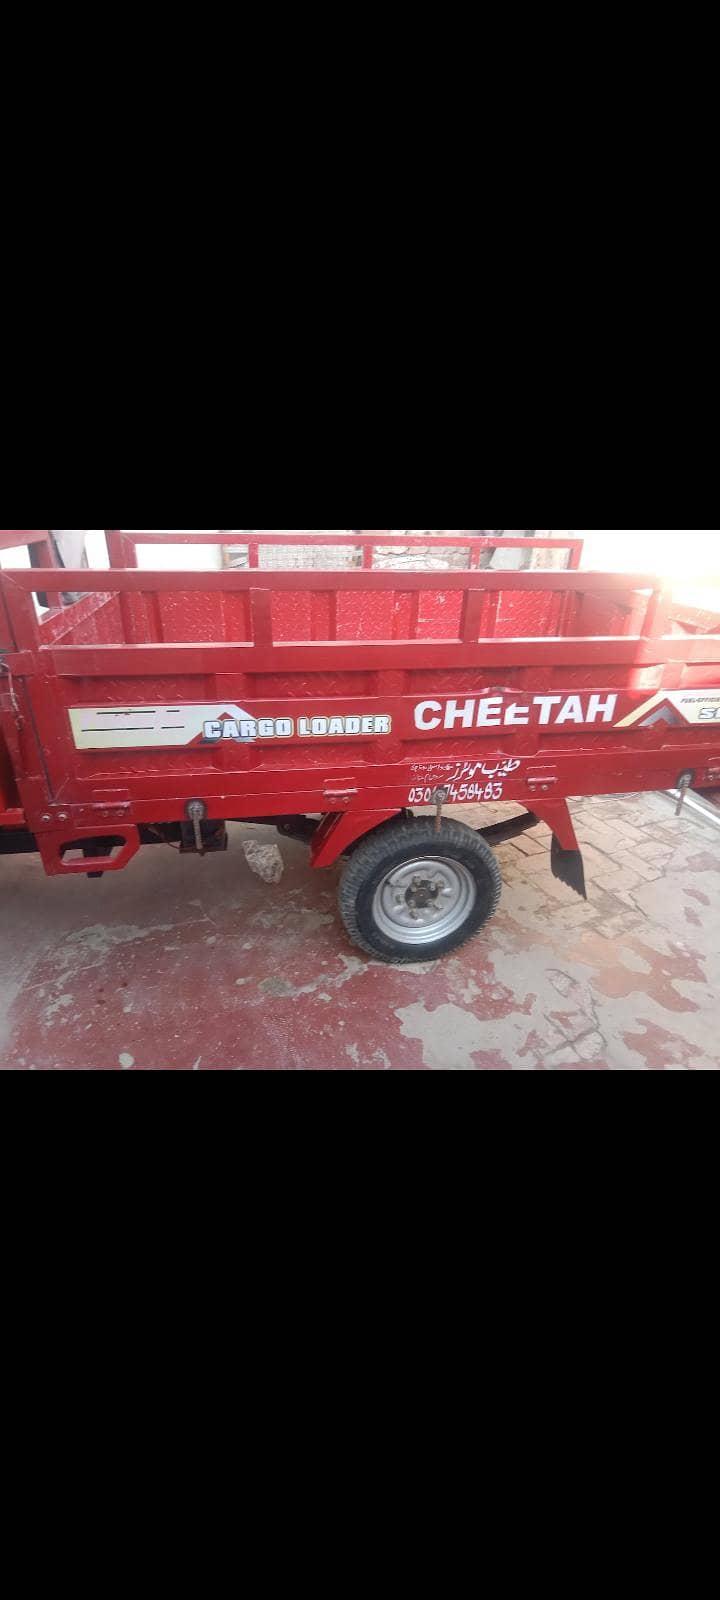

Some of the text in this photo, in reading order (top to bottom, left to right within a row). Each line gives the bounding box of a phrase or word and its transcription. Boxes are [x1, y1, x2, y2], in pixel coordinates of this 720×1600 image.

[202, 714, 391, 739] CARGO LOADER
[414, 693, 617, 731] CHEETAH
